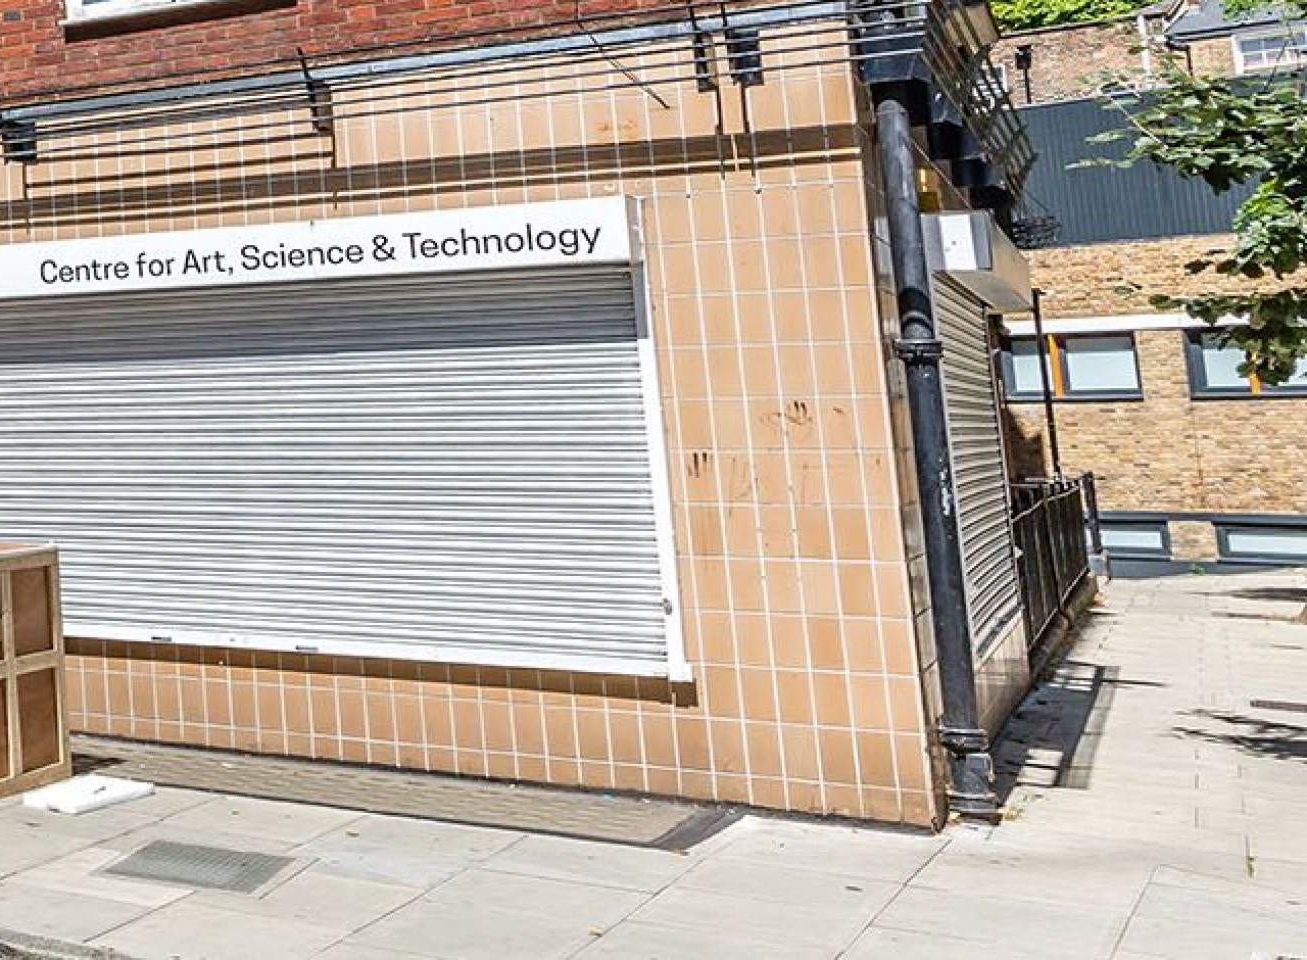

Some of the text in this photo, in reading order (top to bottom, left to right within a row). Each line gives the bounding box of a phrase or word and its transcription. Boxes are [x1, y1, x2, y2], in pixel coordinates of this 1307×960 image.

[40, 223, 601, 285] Centre for Art, Science & Technology
